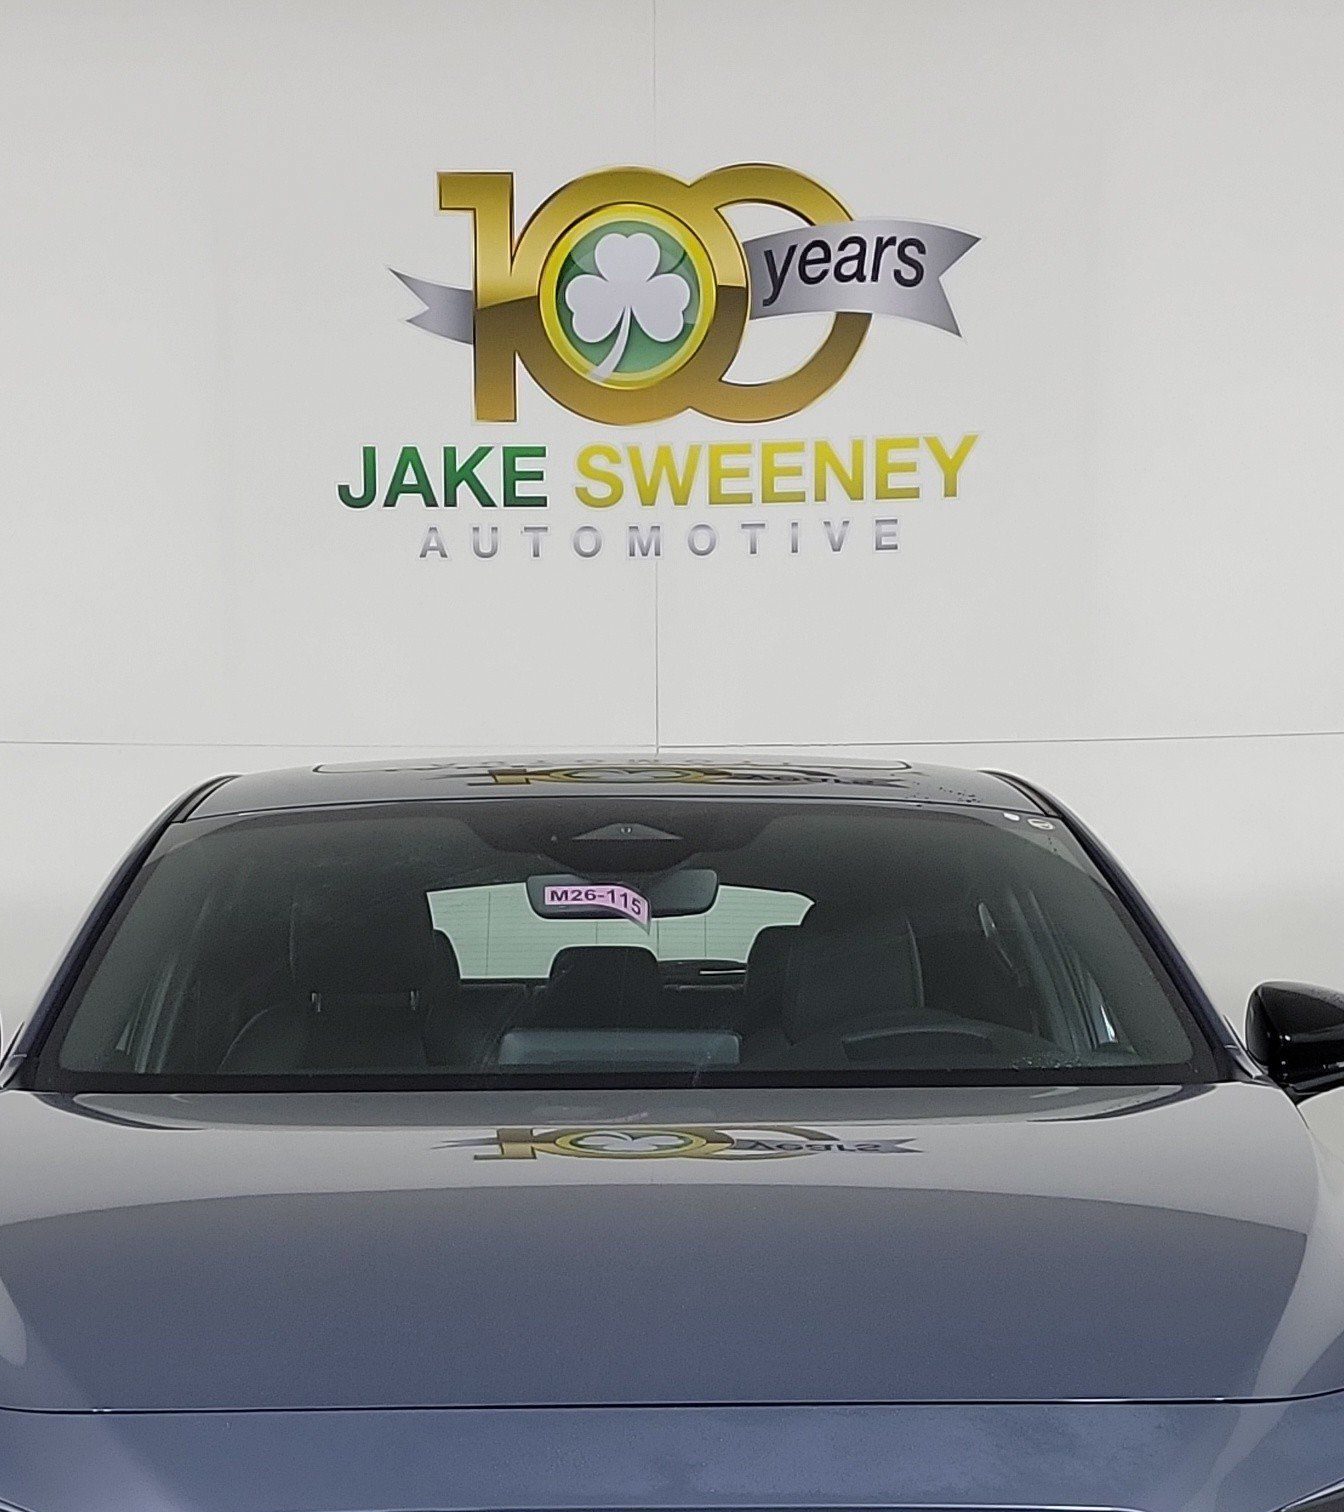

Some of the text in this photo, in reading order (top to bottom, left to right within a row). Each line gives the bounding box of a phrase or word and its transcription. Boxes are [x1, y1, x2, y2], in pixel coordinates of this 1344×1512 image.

[436, 163, 927, 424] 100 years
[337, 433, 979, 508] JAKE SWEENEY
[420, 518, 899, 559] AUTOMOTIVE
[549, 888, 642, 916] M26-115
